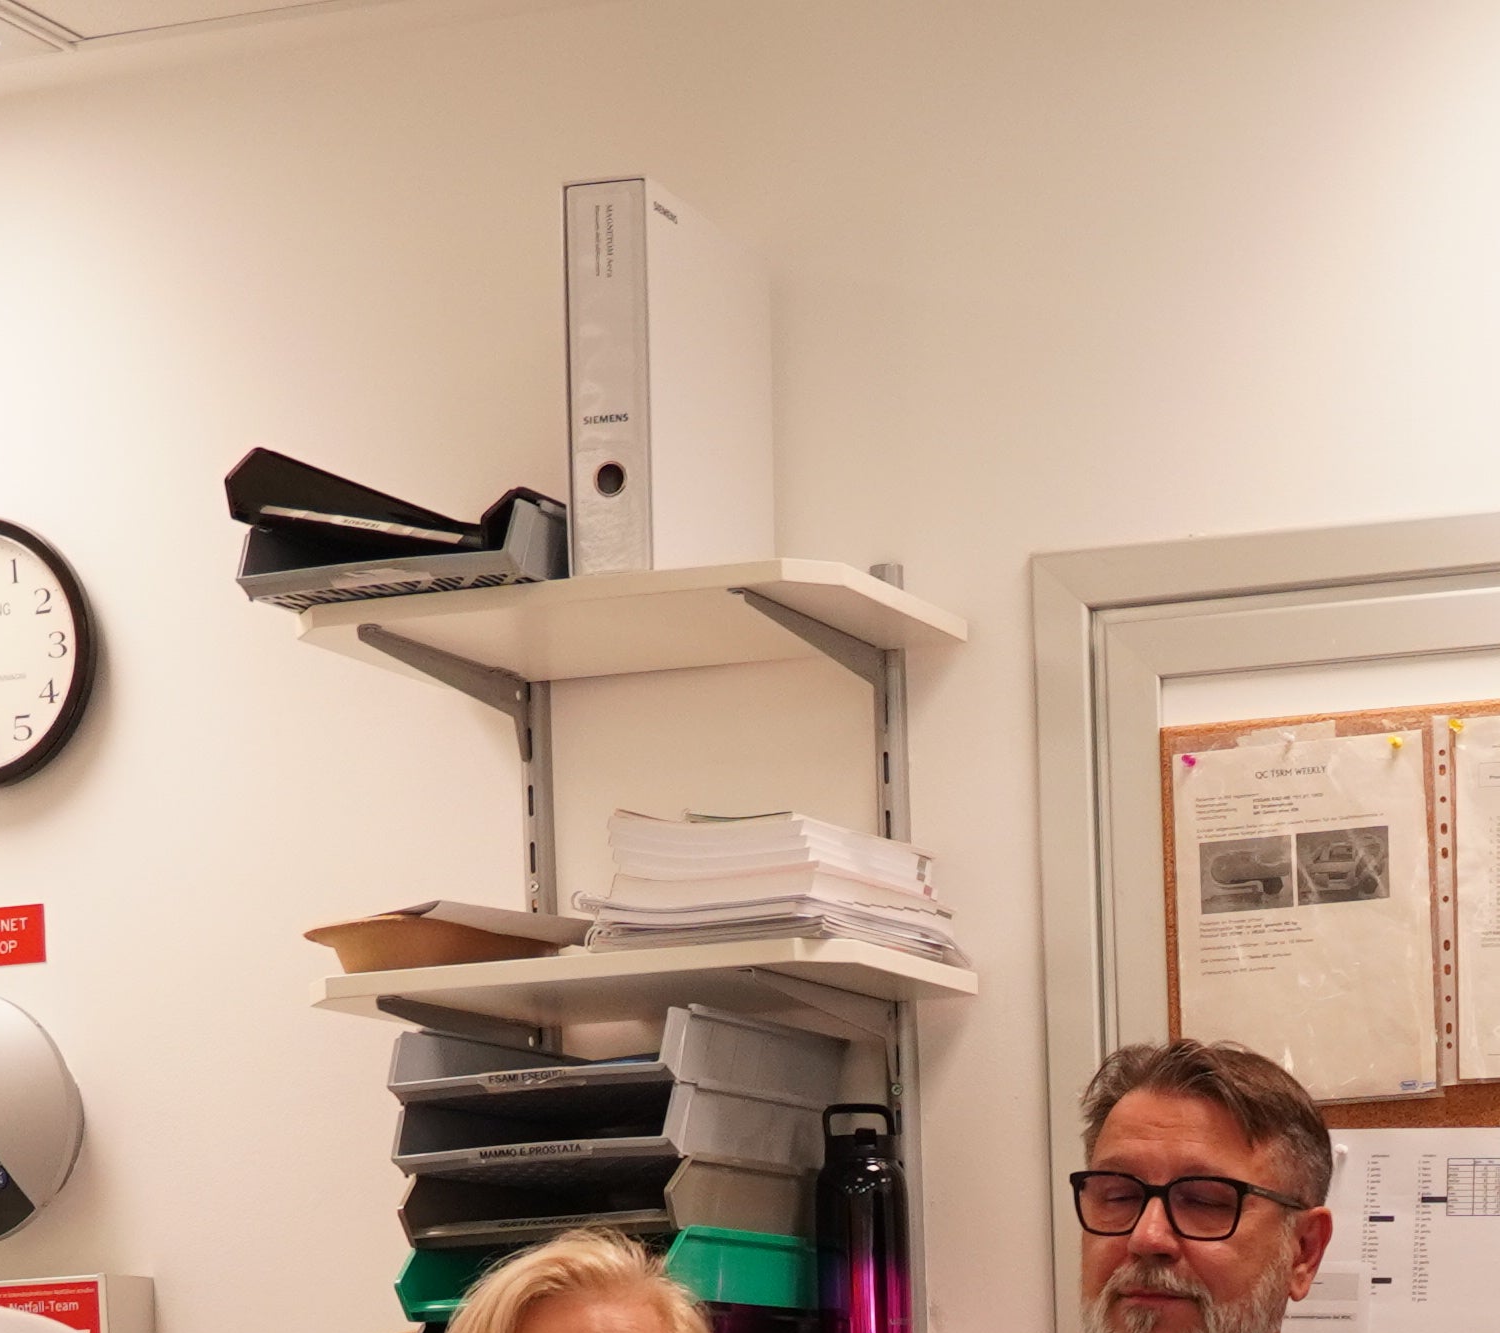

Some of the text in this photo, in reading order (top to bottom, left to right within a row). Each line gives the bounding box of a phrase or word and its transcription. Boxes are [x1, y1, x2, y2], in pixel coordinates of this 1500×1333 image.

[582, 413, 629, 425] SIEMENS
[10, 558, 20, 584] 1
[33, 587, 53, 615] 2
[47, 631, 68, 659] 3
[38, 679, 60, 704] 4
[12, 714, 33, 741] 5
[1254, 770, 1269, 780] QC
[1294, 765, 1326, 776] WEEKLY
[488, 1073, 519, 1084] ESAMI
[479, 1148, 517, 1160] MAMMO
[530, 1143, 582, 1156] PROSTATA
[8, 1300, 80, 1313] Notfall-Team
